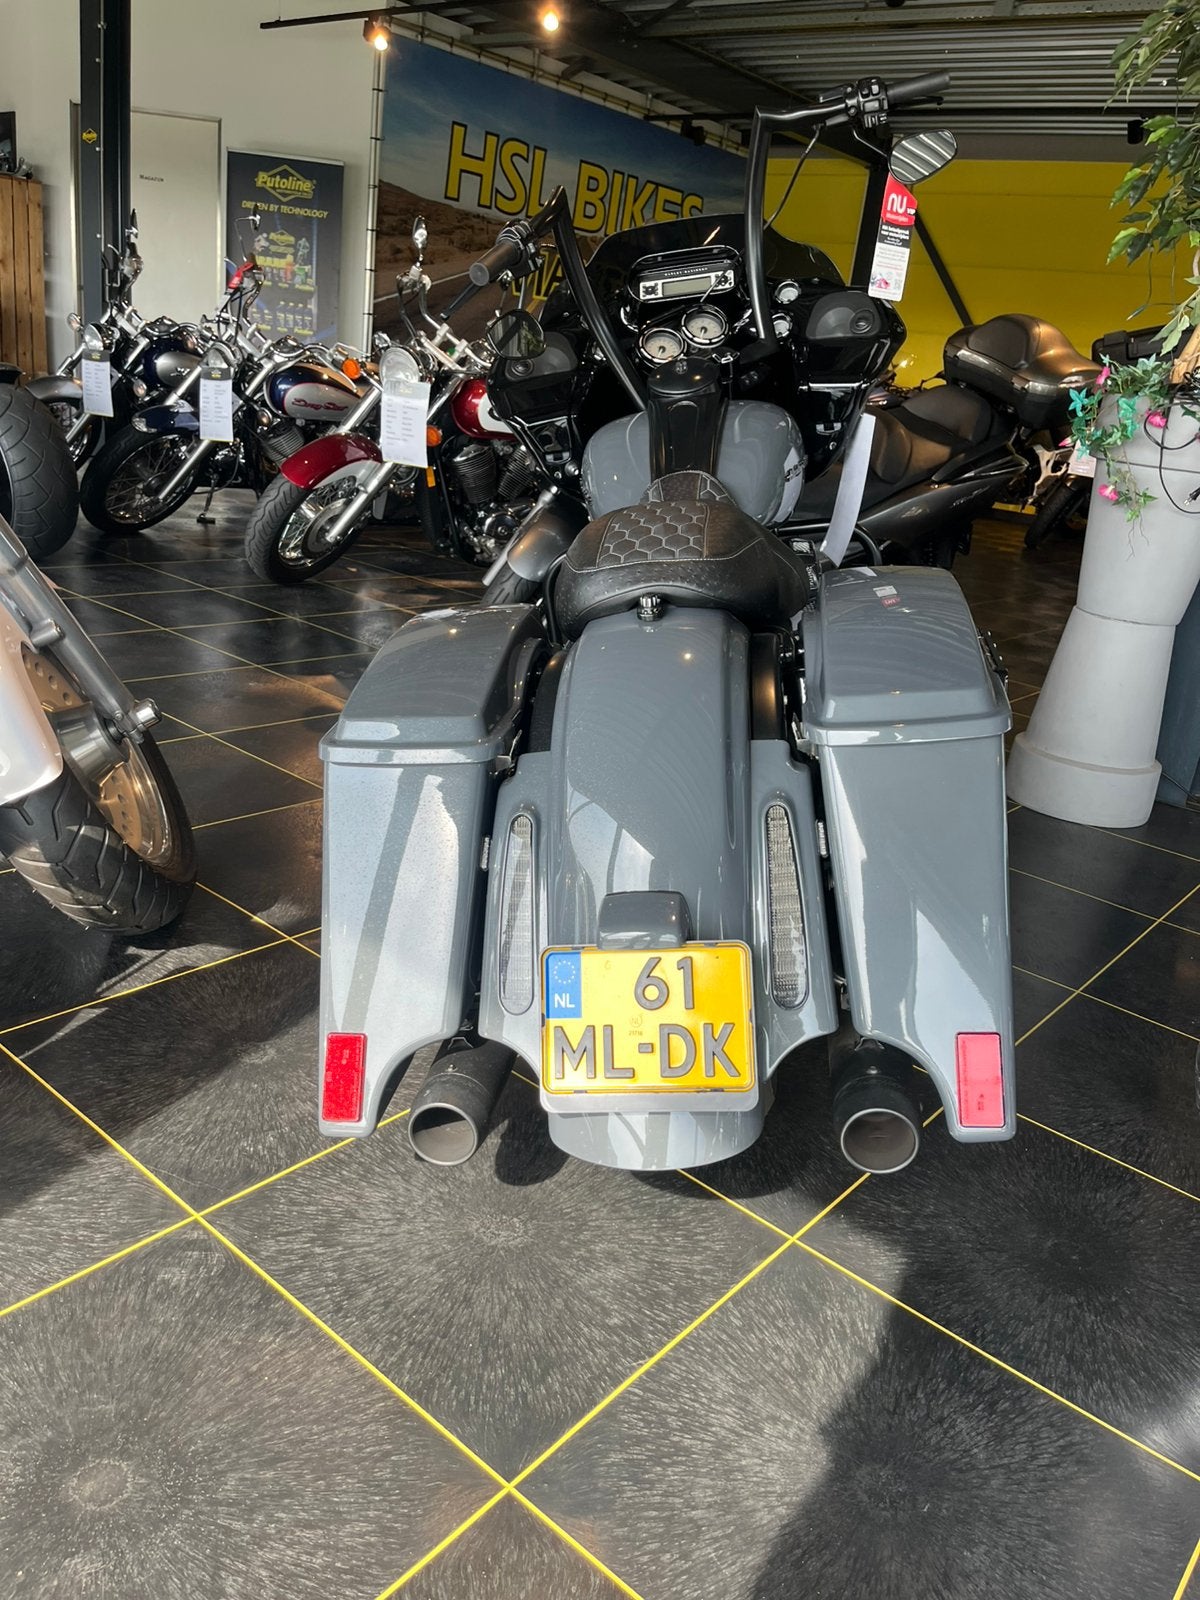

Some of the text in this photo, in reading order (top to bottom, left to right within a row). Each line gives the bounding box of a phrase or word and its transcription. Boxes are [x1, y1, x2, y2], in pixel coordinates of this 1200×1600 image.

[257, 173, 312, 192] Putoline
[445, 121, 548, 219] HSL
[269, 204, 280, 212] BY
[280, 205, 329, 219] TECHNOLOGY
[553, 992, 576, 1009] NL
[634, 956, 695, 1011] 61
[553, 1022, 742, 1080] ML-DK
